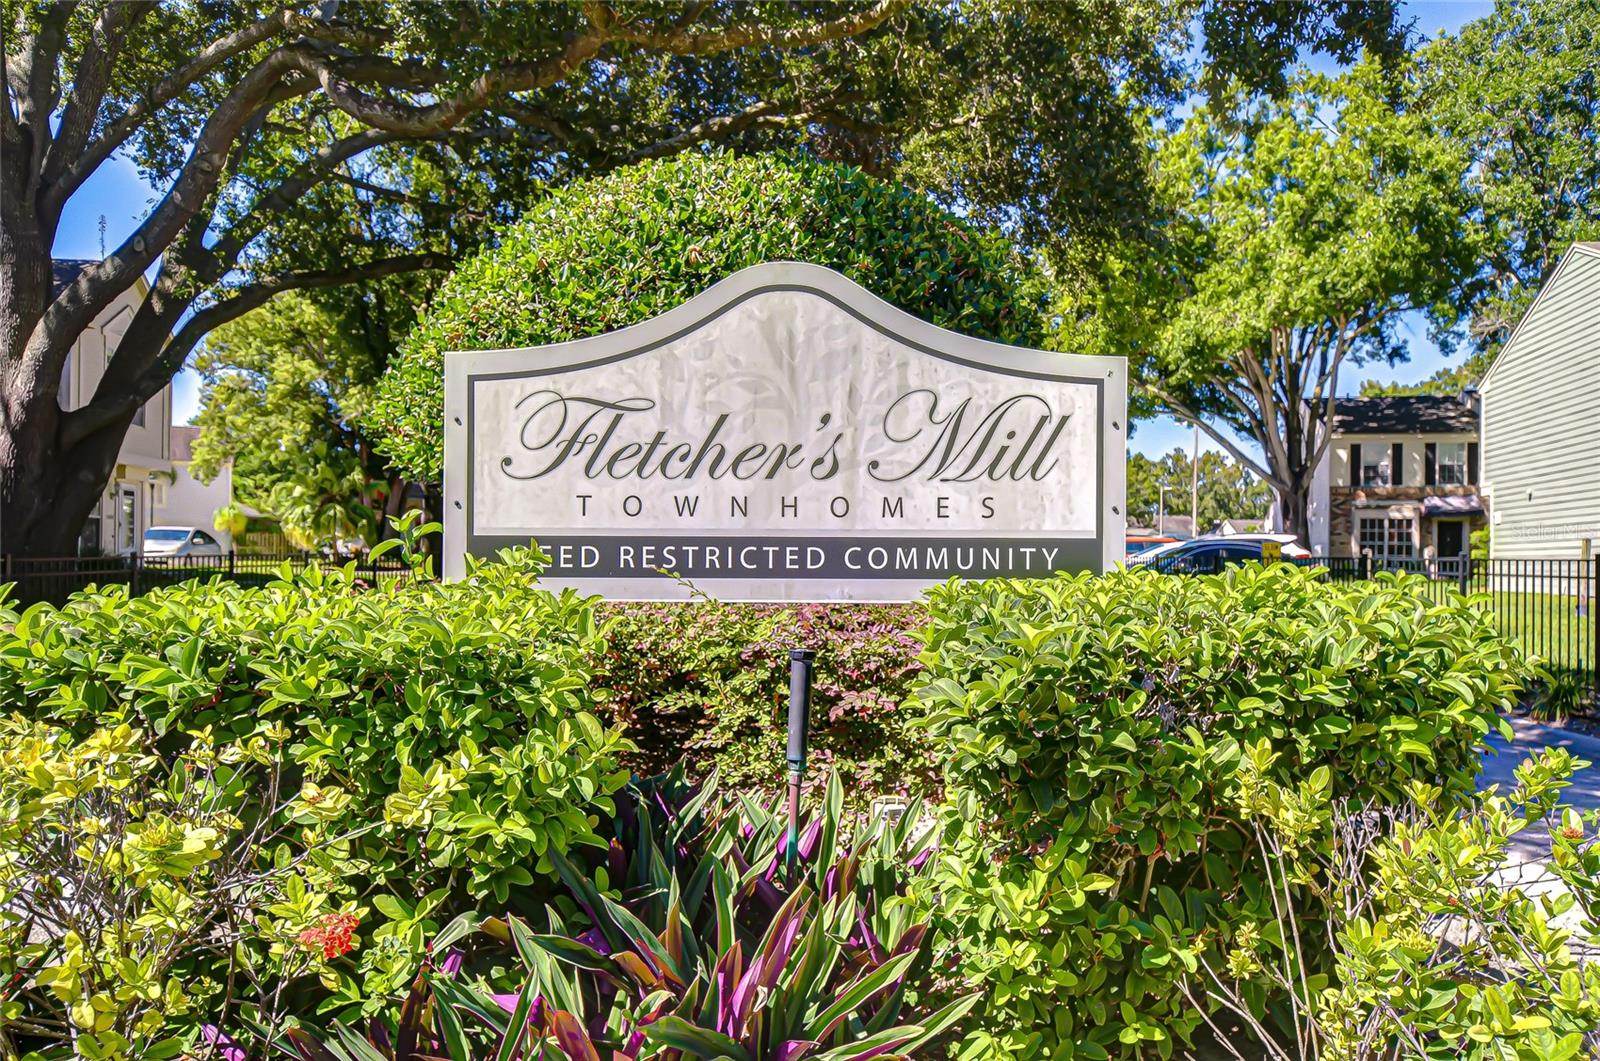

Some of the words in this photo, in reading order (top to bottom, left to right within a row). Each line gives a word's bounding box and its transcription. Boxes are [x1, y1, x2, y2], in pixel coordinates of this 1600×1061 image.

[501, 389, 844, 480] Fletcher's
[867, 388, 1071, 482] Mill
[576, 495, 995, 519] TOWNHOMES
[619, 546, 825, 569] RESTRICTED
[844, 547, 1061, 571] COMMUNITY
